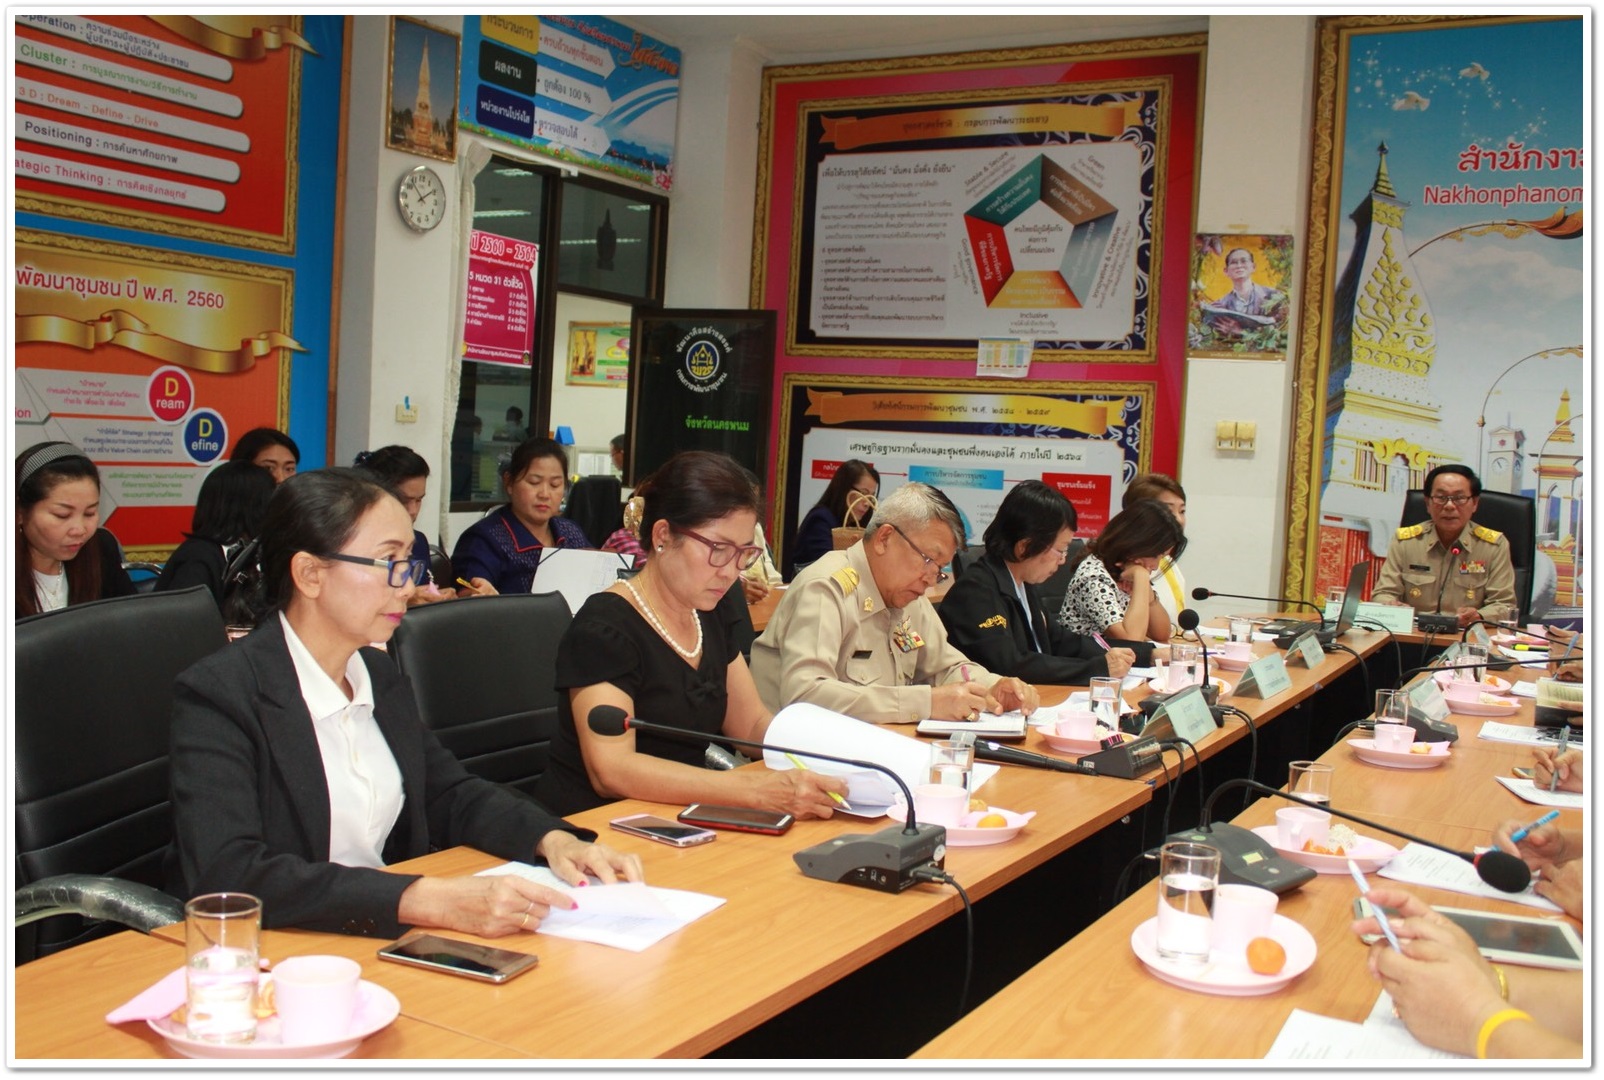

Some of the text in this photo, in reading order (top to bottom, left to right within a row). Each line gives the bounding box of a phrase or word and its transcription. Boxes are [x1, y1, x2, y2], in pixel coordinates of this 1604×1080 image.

[20, 15, 76, 33] peration
[20, 44, 68, 69] Cluster
[494, 59, 522, 79] ผลงาน
[569, 87, 581, 100] 100
[19, 86, 27, 97] 3
[29, 88, 38, 99] D
[47, 93, 81, 110] Dream
[92, 104, 124, 120] Define
[134, 114, 160, 128] Drive
[24, 121, 93, 148] Positioning
[54, 166, 104, 186] Thinking
[1425, 185, 1583, 207] Nakhonphanom
[480, 236, 505, 256] 2560
[514, 243, 537, 263] 2564
[16, 266, 224, 310] พัฒนาชุมชน ปี พ.ศ. 2560
[493, 275, 502, 286] 31
[1020, 312, 1048, 320] Inclusive
[164, 376, 179, 397] D
[156, 399, 185, 411] ream
[199, 418, 213, 437] D
[191, 439, 219, 451] efine
[1020, 447, 1052, 460] ภายในปี
